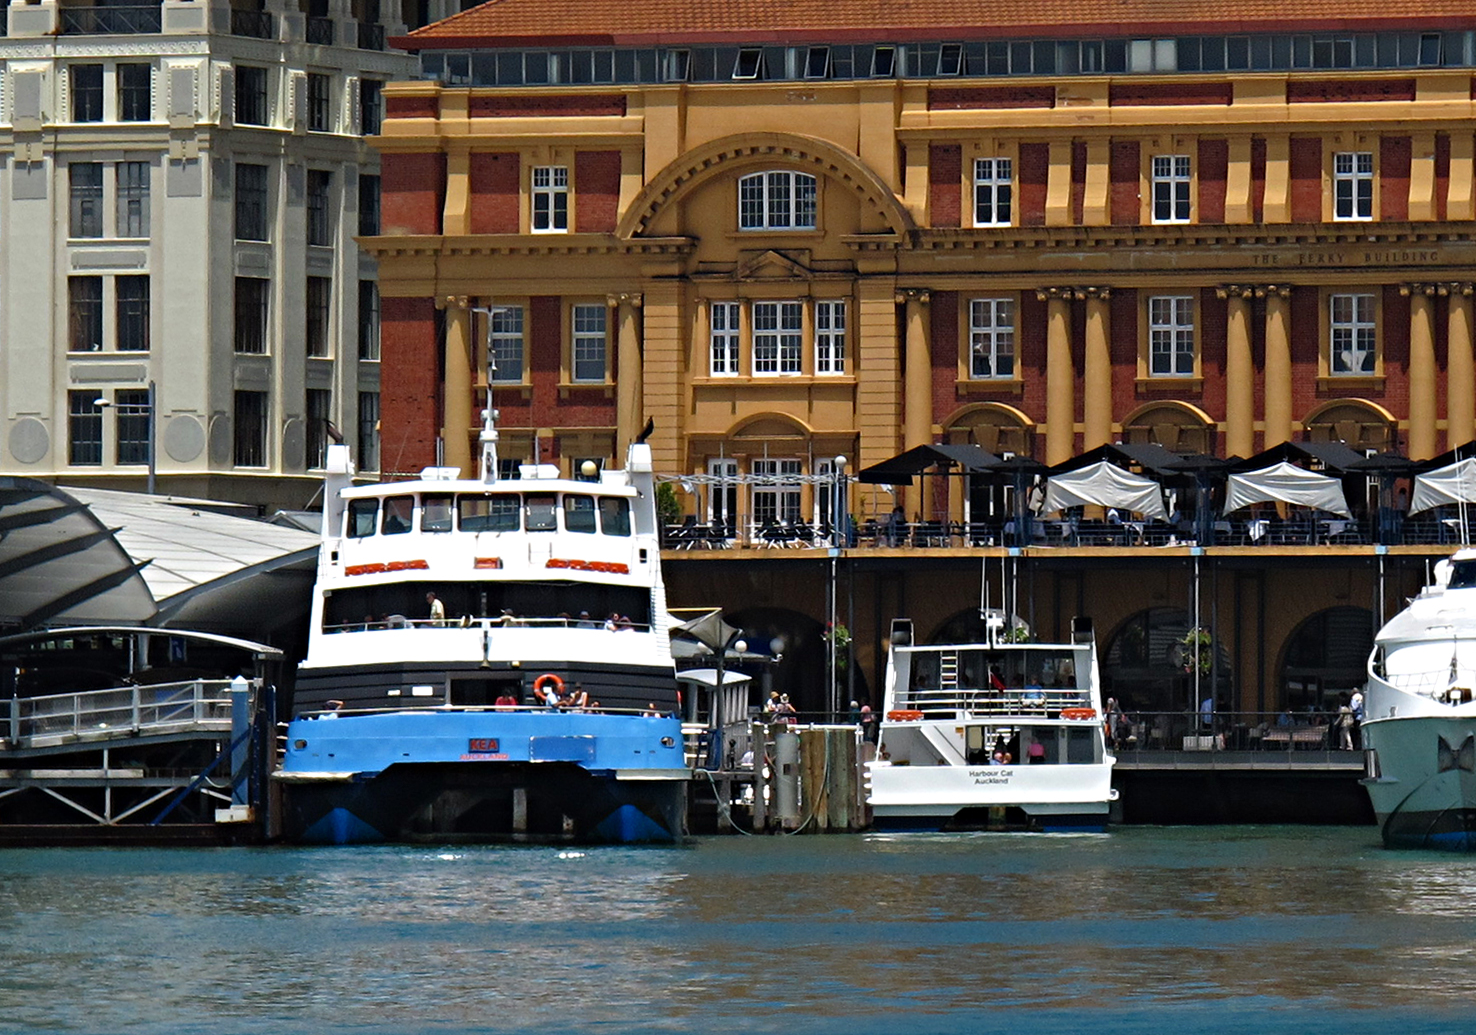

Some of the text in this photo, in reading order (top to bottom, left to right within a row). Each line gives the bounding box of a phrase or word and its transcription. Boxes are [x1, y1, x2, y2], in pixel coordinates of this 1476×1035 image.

[1254, 251, 1438, 264] THE FERRY BUILDING
[470, 739, 497, 750] KEA
[974, 777, 1009, 785] Auckland
